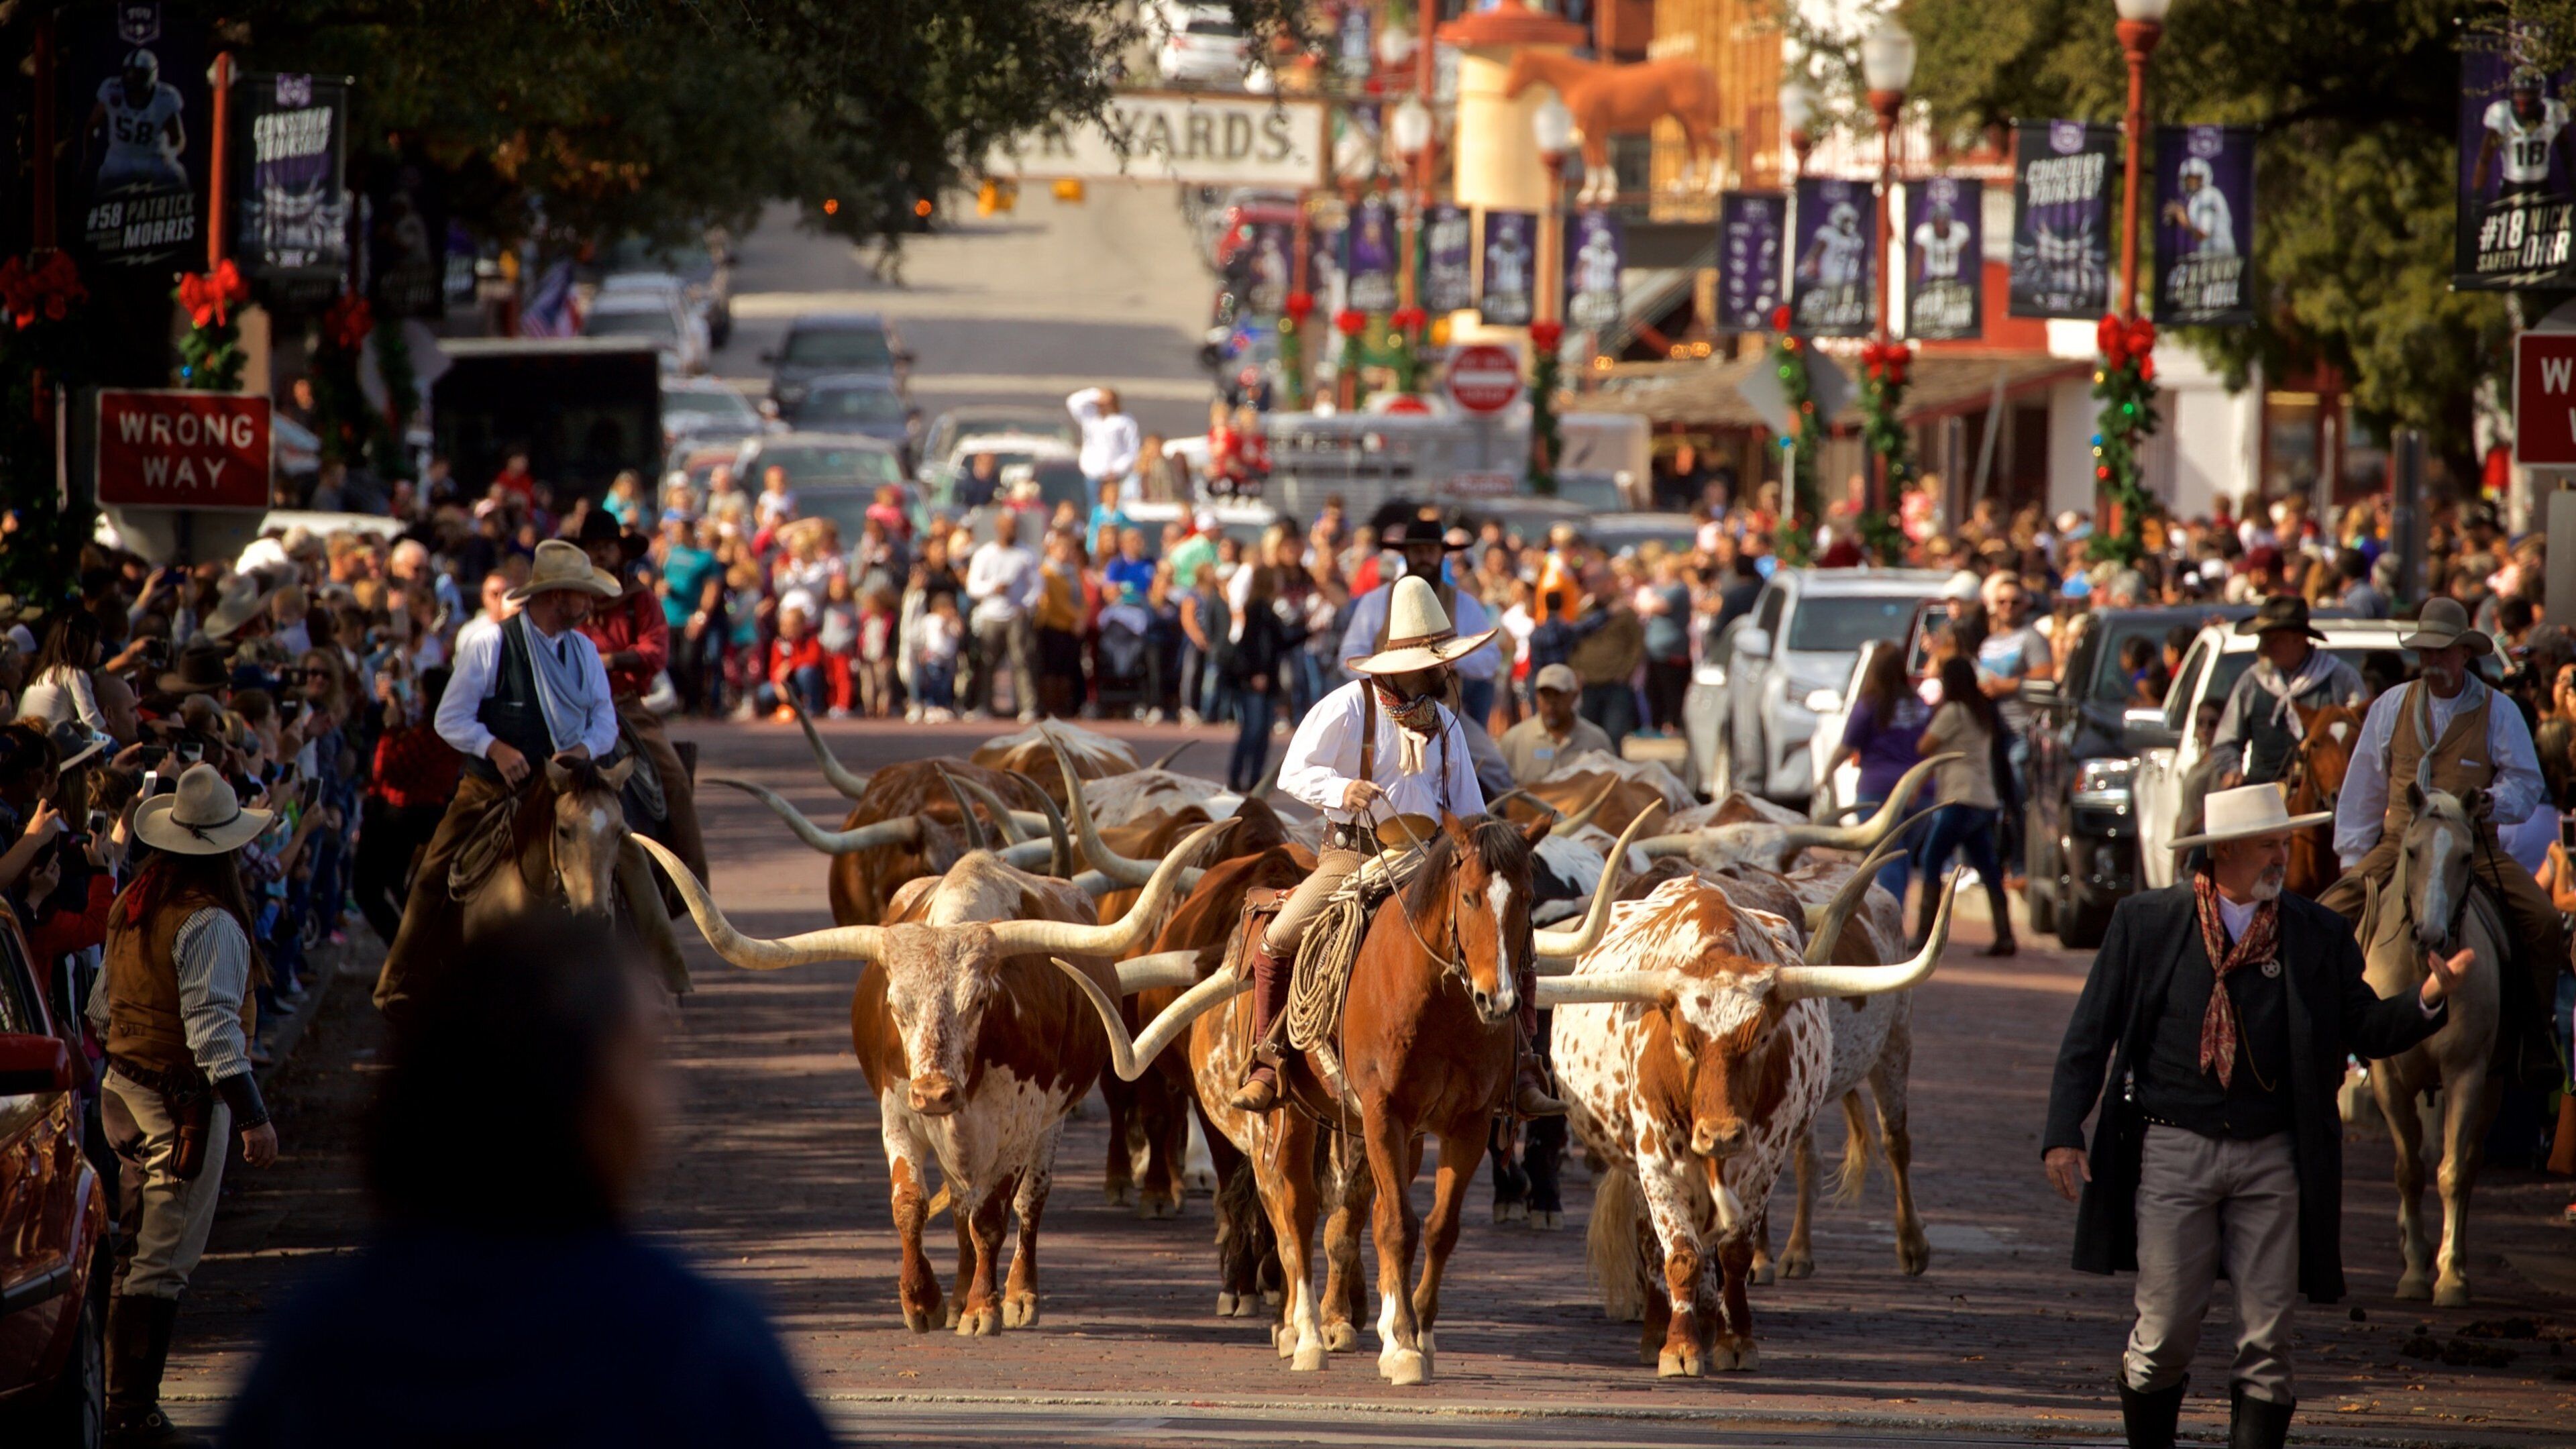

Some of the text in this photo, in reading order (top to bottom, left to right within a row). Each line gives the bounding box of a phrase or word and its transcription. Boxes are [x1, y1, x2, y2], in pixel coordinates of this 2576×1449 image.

[116, 116, 154, 144] 58
[1112, 109, 1293, 162] YARDS
[2514, 141, 2547, 167] 18
[87, 192, 197, 231] #58 PATRICK
[2479, 203, 2575, 253] #18 NICK
[123, 215, 196, 251] MORRIS
[2522, 229, 2572, 268] ORR
[118, 410, 254, 449] WRONG
[142, 455, 228, 490] WAY
